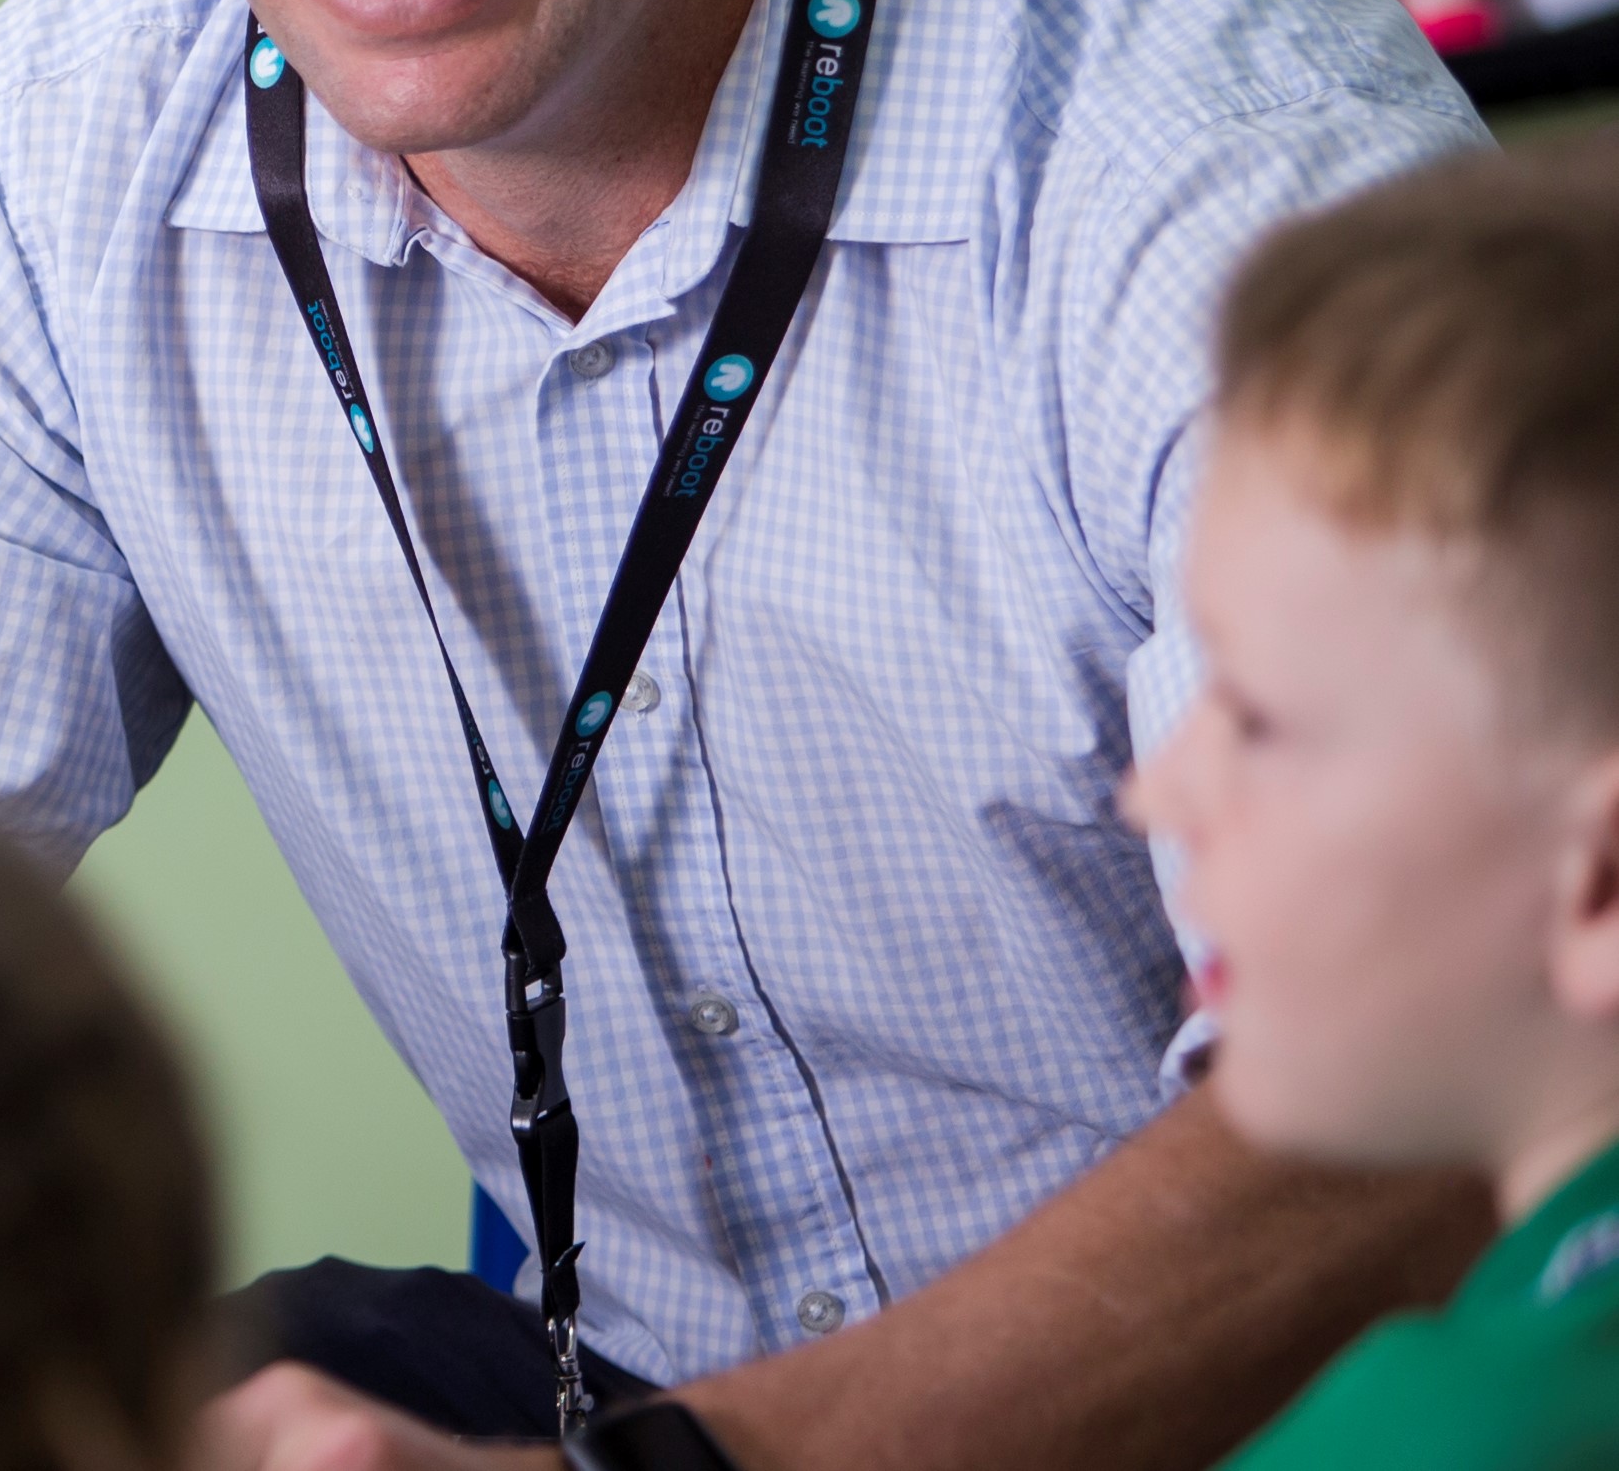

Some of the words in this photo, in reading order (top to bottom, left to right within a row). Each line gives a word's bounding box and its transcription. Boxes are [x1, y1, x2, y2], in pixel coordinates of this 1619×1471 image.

[801, 43, 844, 148] reboot
[308, 300, 353, 400] reboot
[675, 407, 730, 498] reboot
[547, 741, 591, 832] reboot
